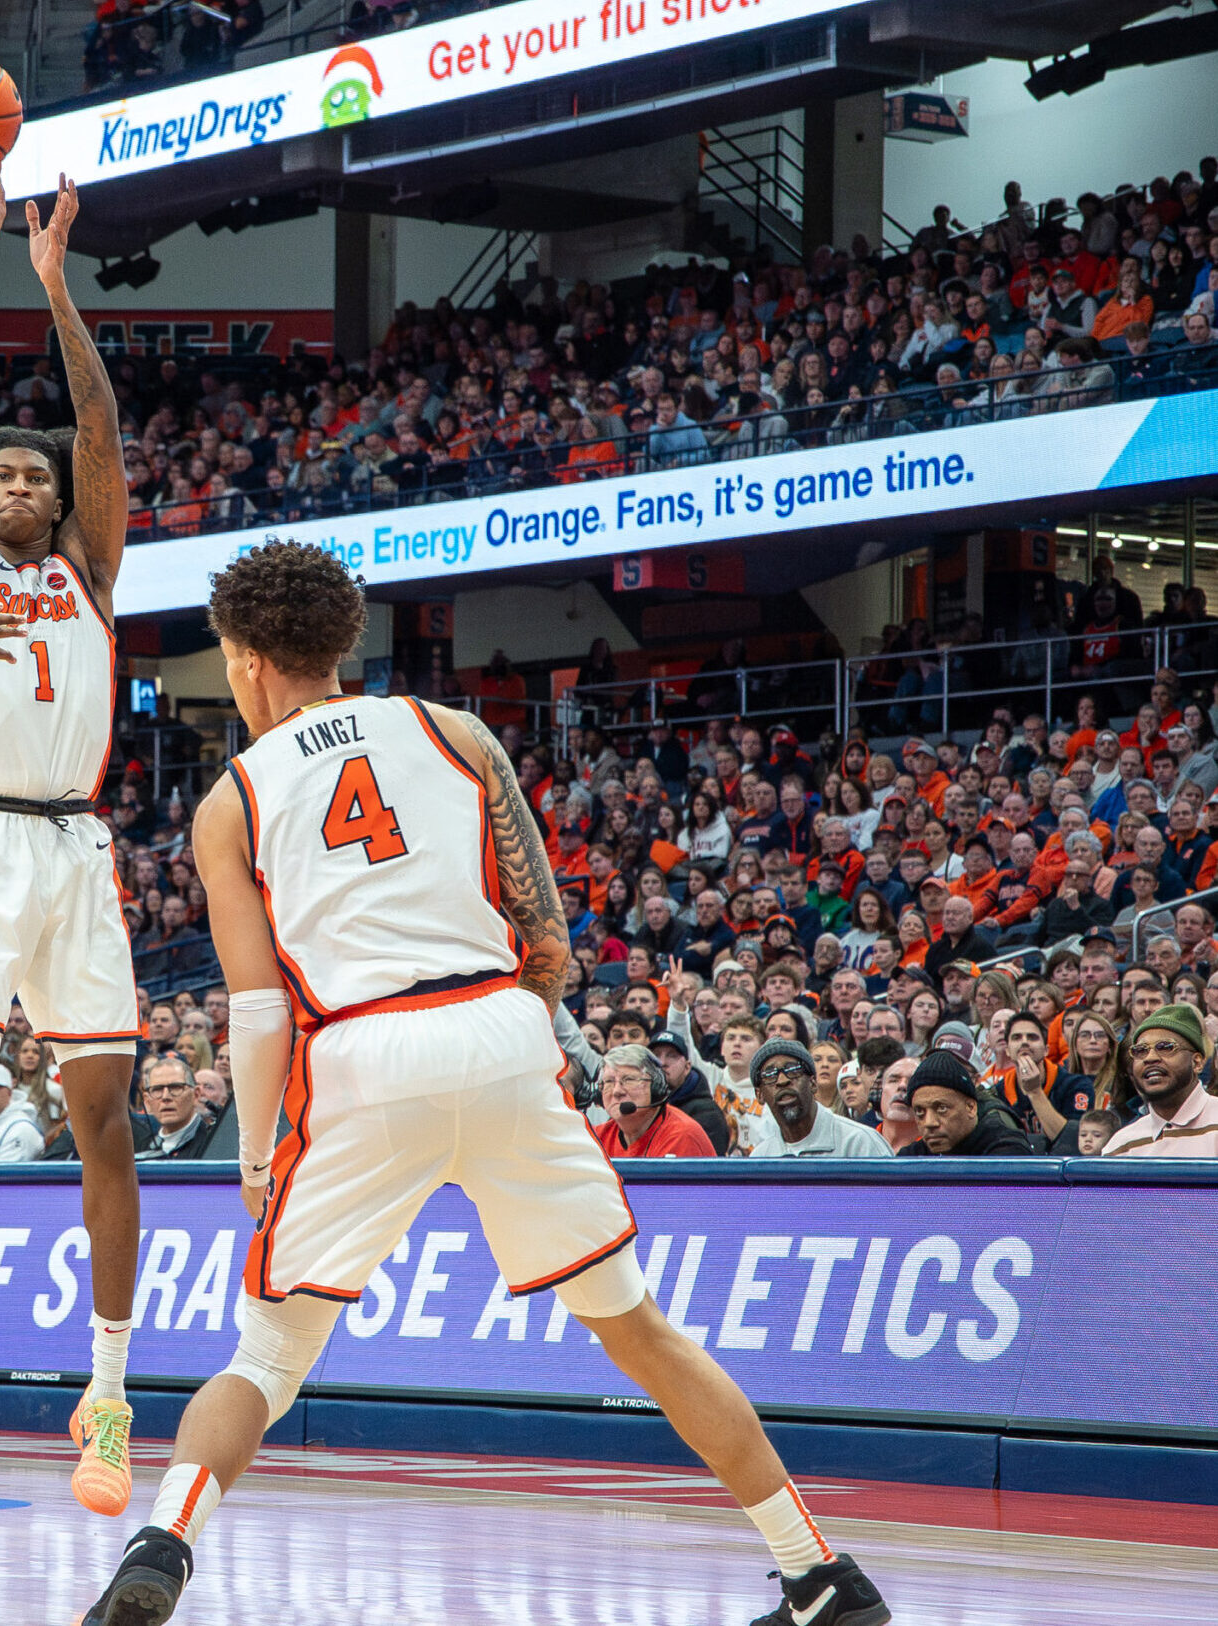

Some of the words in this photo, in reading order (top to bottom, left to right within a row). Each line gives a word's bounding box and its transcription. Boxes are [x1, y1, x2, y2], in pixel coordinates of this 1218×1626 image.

[428, 34, 491, 80] Get
[504, 17, 586, 74] your
[600, 0, 646, 41] flu
[661, 0, 760, 25] sh.
[98, 93, 286, 166] KinneyDrugs
[47, 321, 213, 355] ATE
[321, 536, 365, 569] the
[373, 525, 478, 565] Energy
[617, 490, 703, 528] Fans,
[714, 474, 764, 516] it's
[774, 467, 873, 519] game
[883, 451, 974, 493] time.
[621, 552, 643, 589] S
[29, 640, 54, 702] 1
[294, 714, 365, 757] KINGZ
[321, 754, 410, 865] 4
[1075, 1092, 1089, 1112] S
[32, 1226, 470, 1339] SRASE
[471, 1234, 1035, 1362] ALETICS
[10, 1371, 62, 1382] DAKTRONICS
